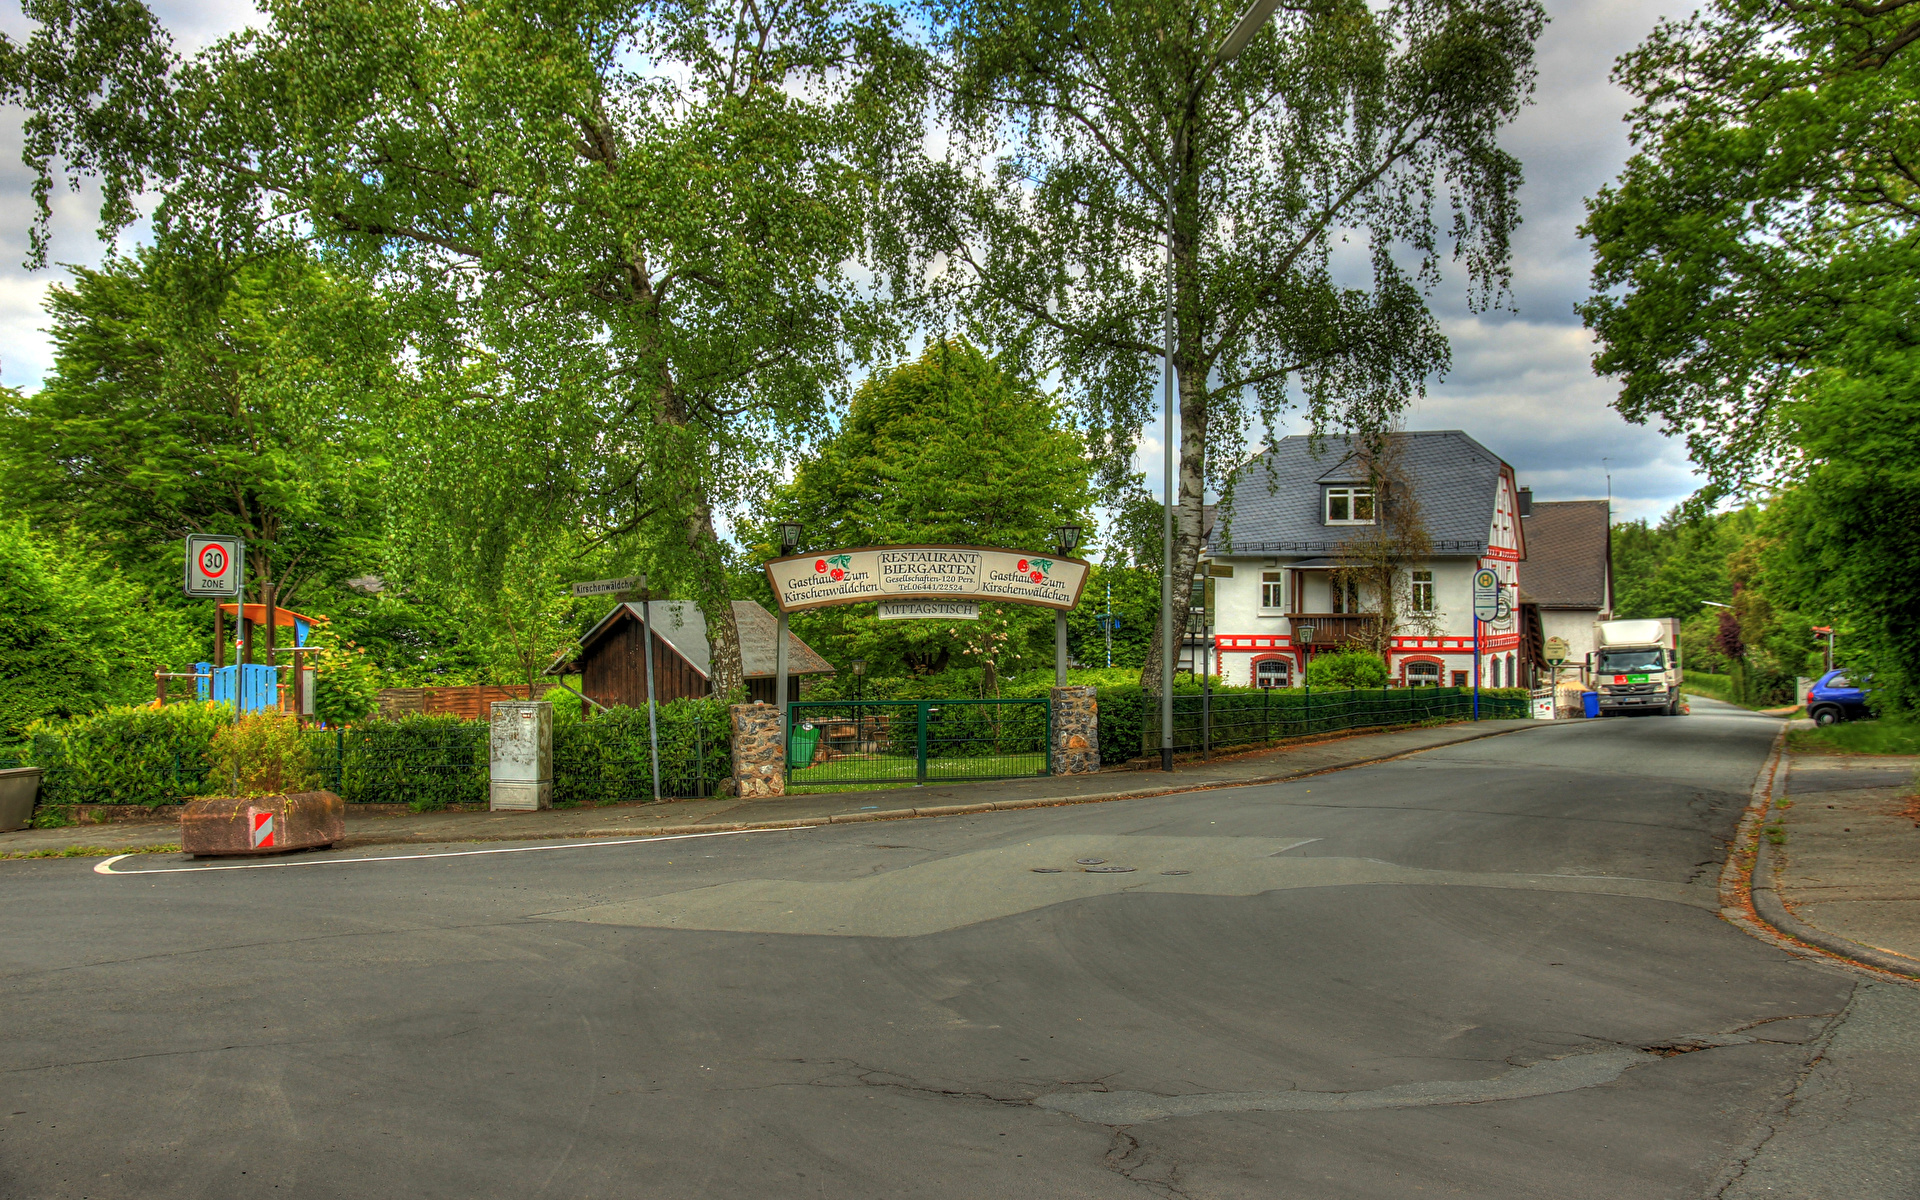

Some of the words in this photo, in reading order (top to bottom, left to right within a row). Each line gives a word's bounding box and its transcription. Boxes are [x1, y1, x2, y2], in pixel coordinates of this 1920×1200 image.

[205, 553, 222, 568] 30
[882, 552, 979, 563] RESTAURANT
[883, 564, 977, 575] BIERGARTEN
[202, 579, 224, 588] ZONE
[576, 579, 637, 594] Kirschenwäldche
[788, 573, 836, 589] Gasthaus
[843, 571, 869, 582] Zum
[957, 576, 975, 584] Pers.
[989, 570, 1034, 584] Gasthaus
[1041, 576, 1065, 589] Zum
[784, 581, 879, 603] Kirschenwäldchen
[982, 581, 1070, 602] Kirschenwäldchen
[884, 603, 974, 615] MITTAGSTISCH
